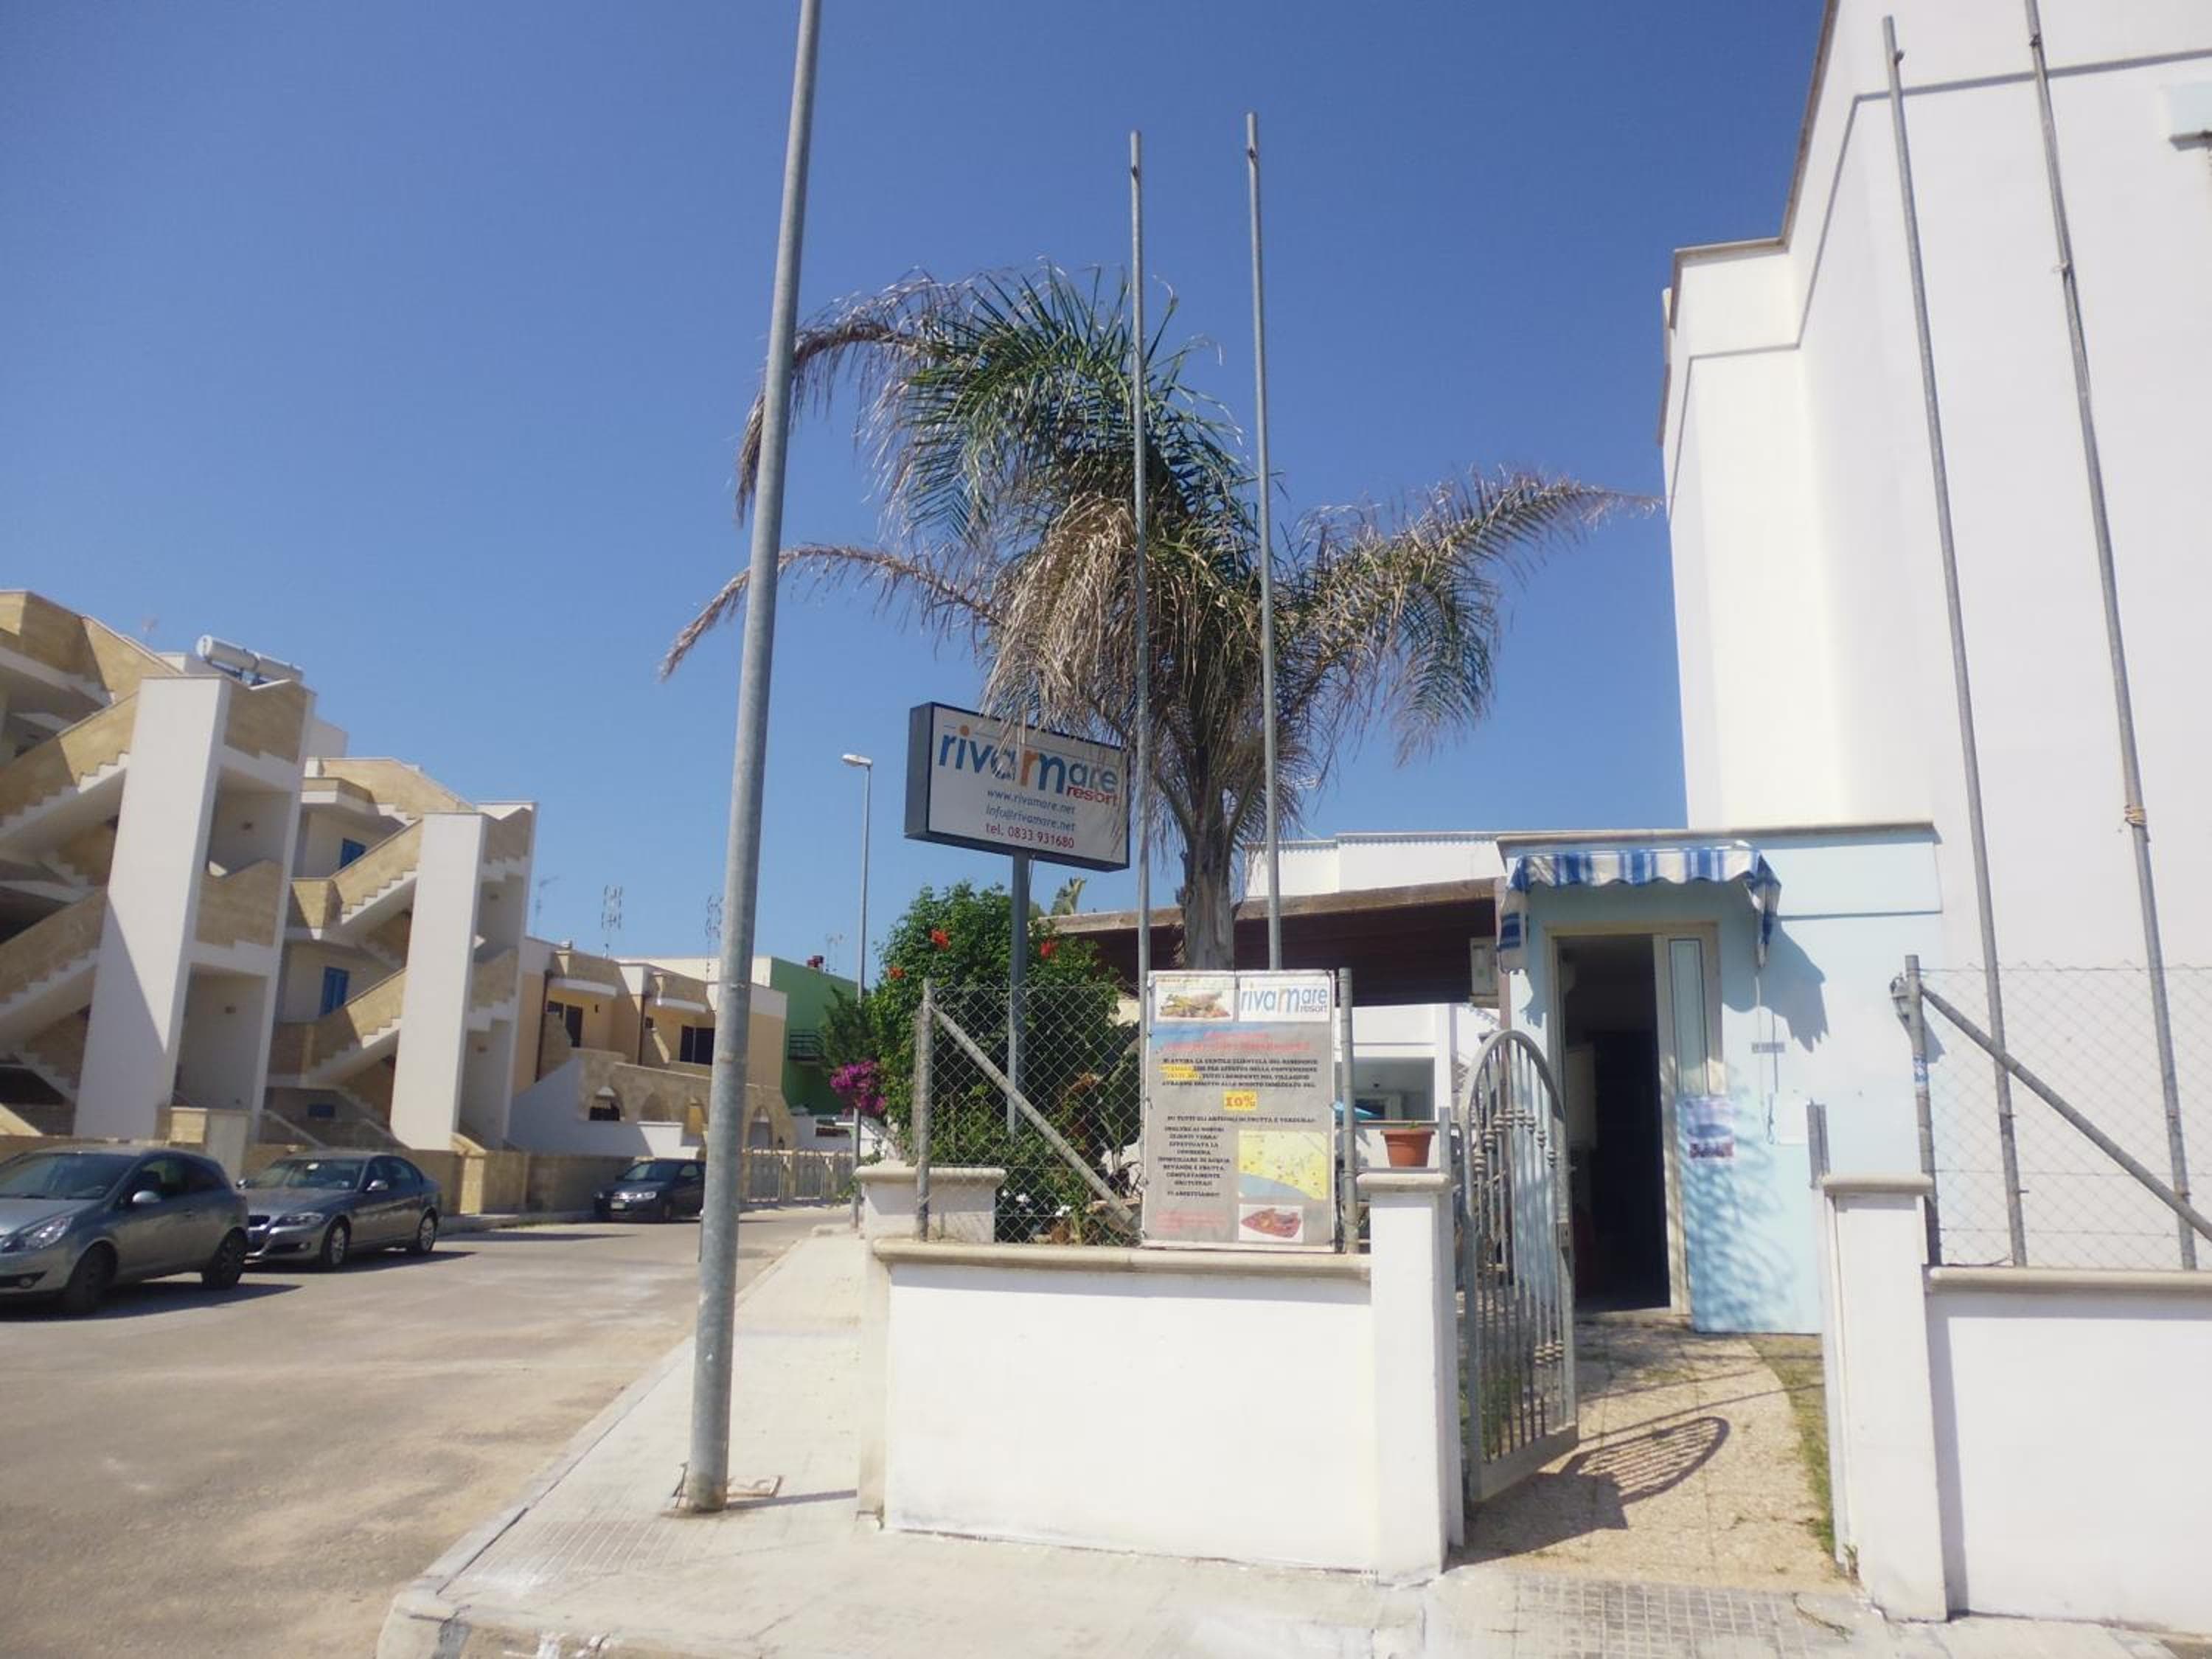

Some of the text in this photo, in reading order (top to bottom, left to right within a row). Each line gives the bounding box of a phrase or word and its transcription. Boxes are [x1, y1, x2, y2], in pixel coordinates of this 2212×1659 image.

[939, 725, 1118, 793] rivamare
[987, 790, 1076, 814] www.rivamare.net
[1066, 785, 1118, 806] resort
[987, 804, 1077, 831] info@rivamare.net
[1008, 826, 1033, 841] 0833
[1037, 831, 1074, 848] 931680
[1240, 983, 1327, 1015] rivamare
[1299, 1005, 1328, 1014] resort
